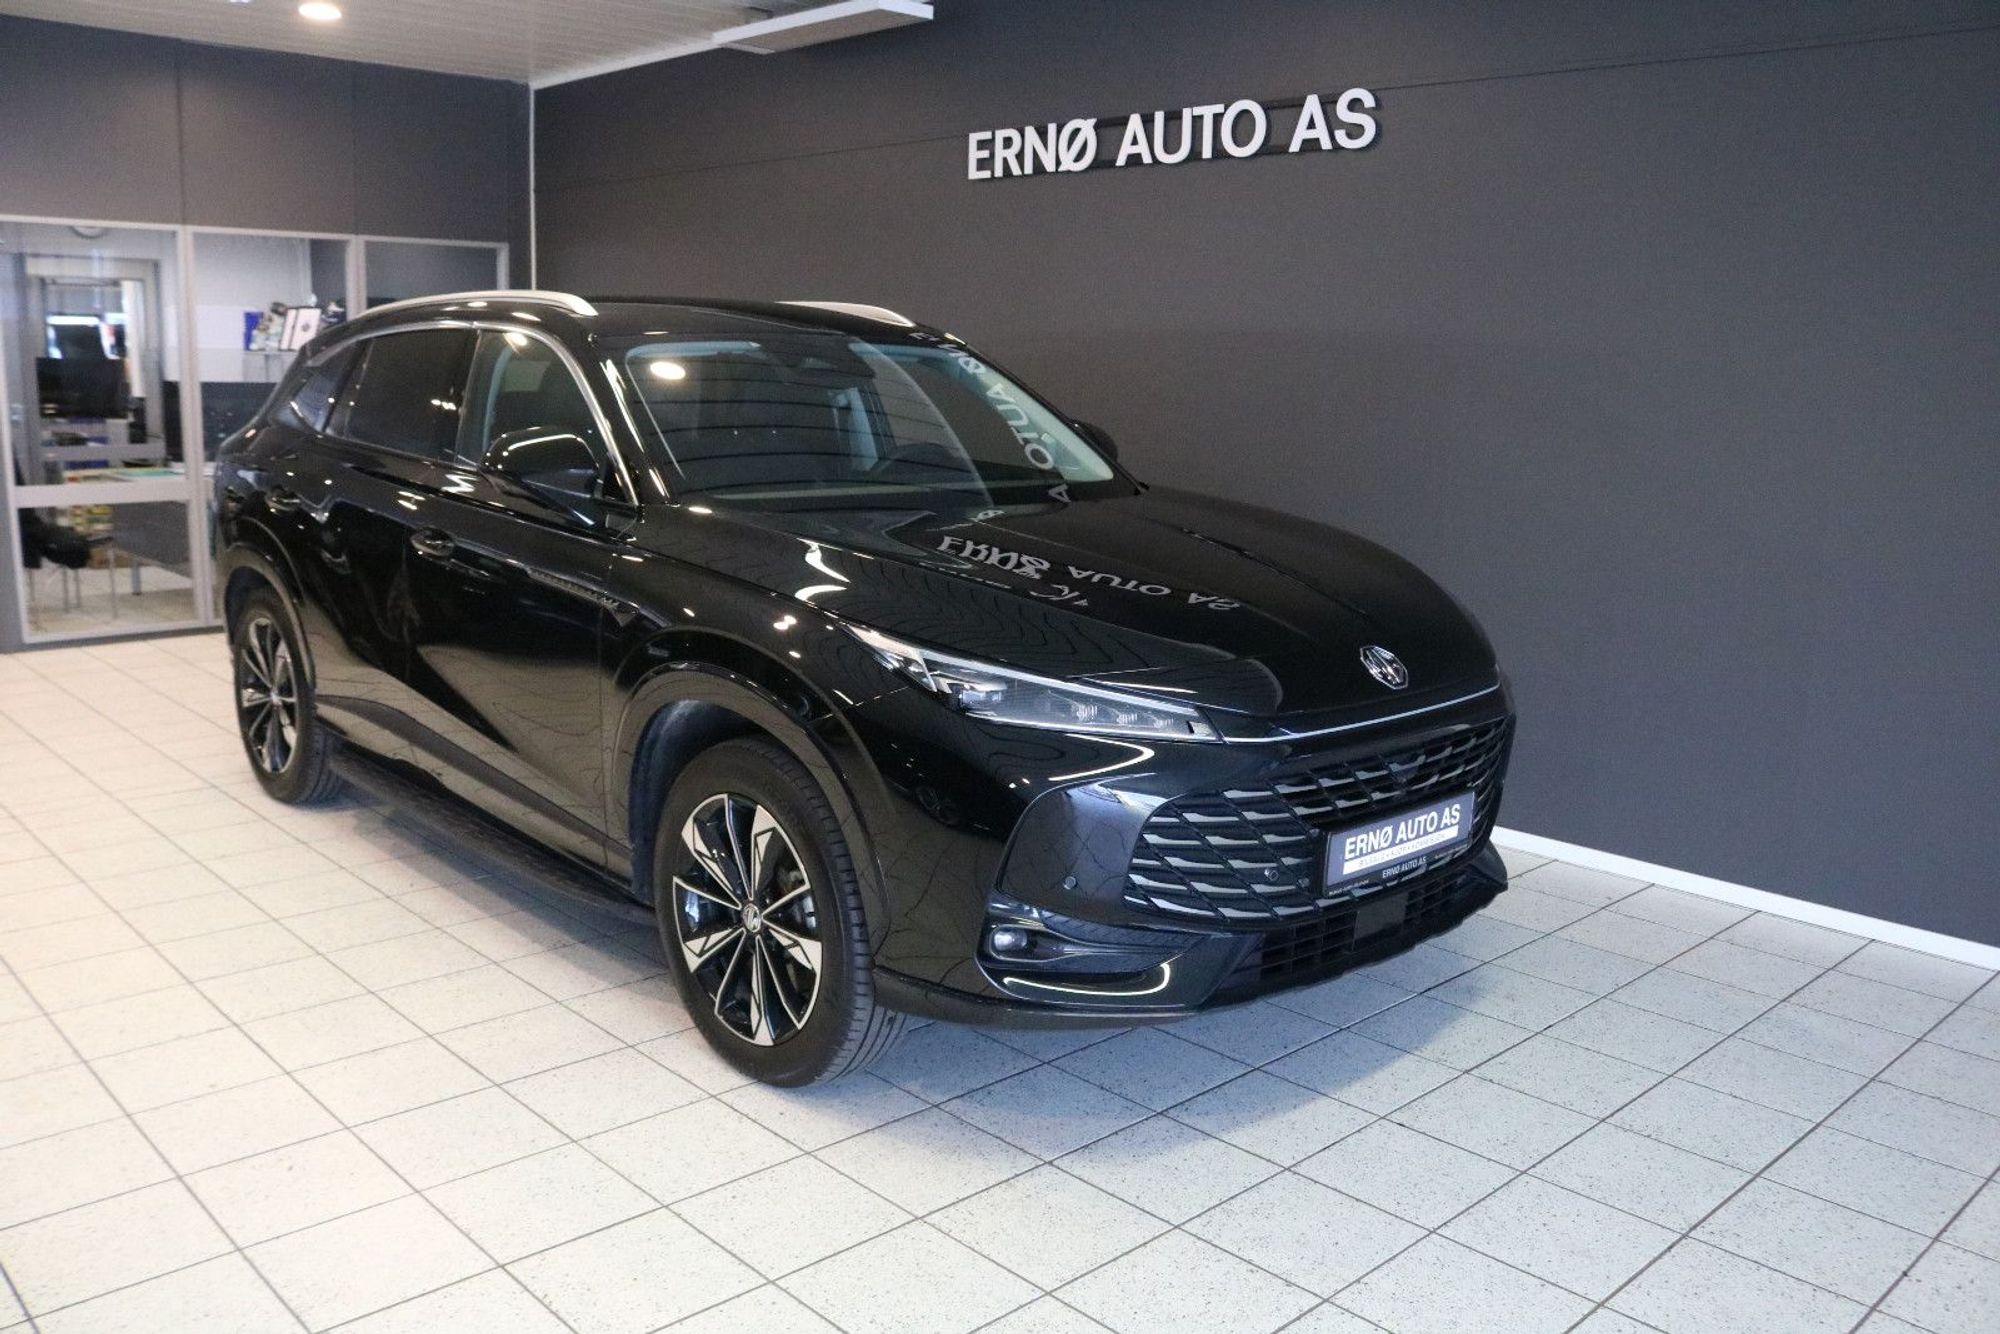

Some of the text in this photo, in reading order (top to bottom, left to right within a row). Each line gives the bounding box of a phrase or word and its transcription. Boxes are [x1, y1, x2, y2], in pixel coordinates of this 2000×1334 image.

[968, 88, 1377, 180] ERNØ AUTO AS
[1345, 825, 1393, 860] ERNØ
[1396, 811, 1438, 843] AUTO
[1441, 804, 1461, 828] AS
